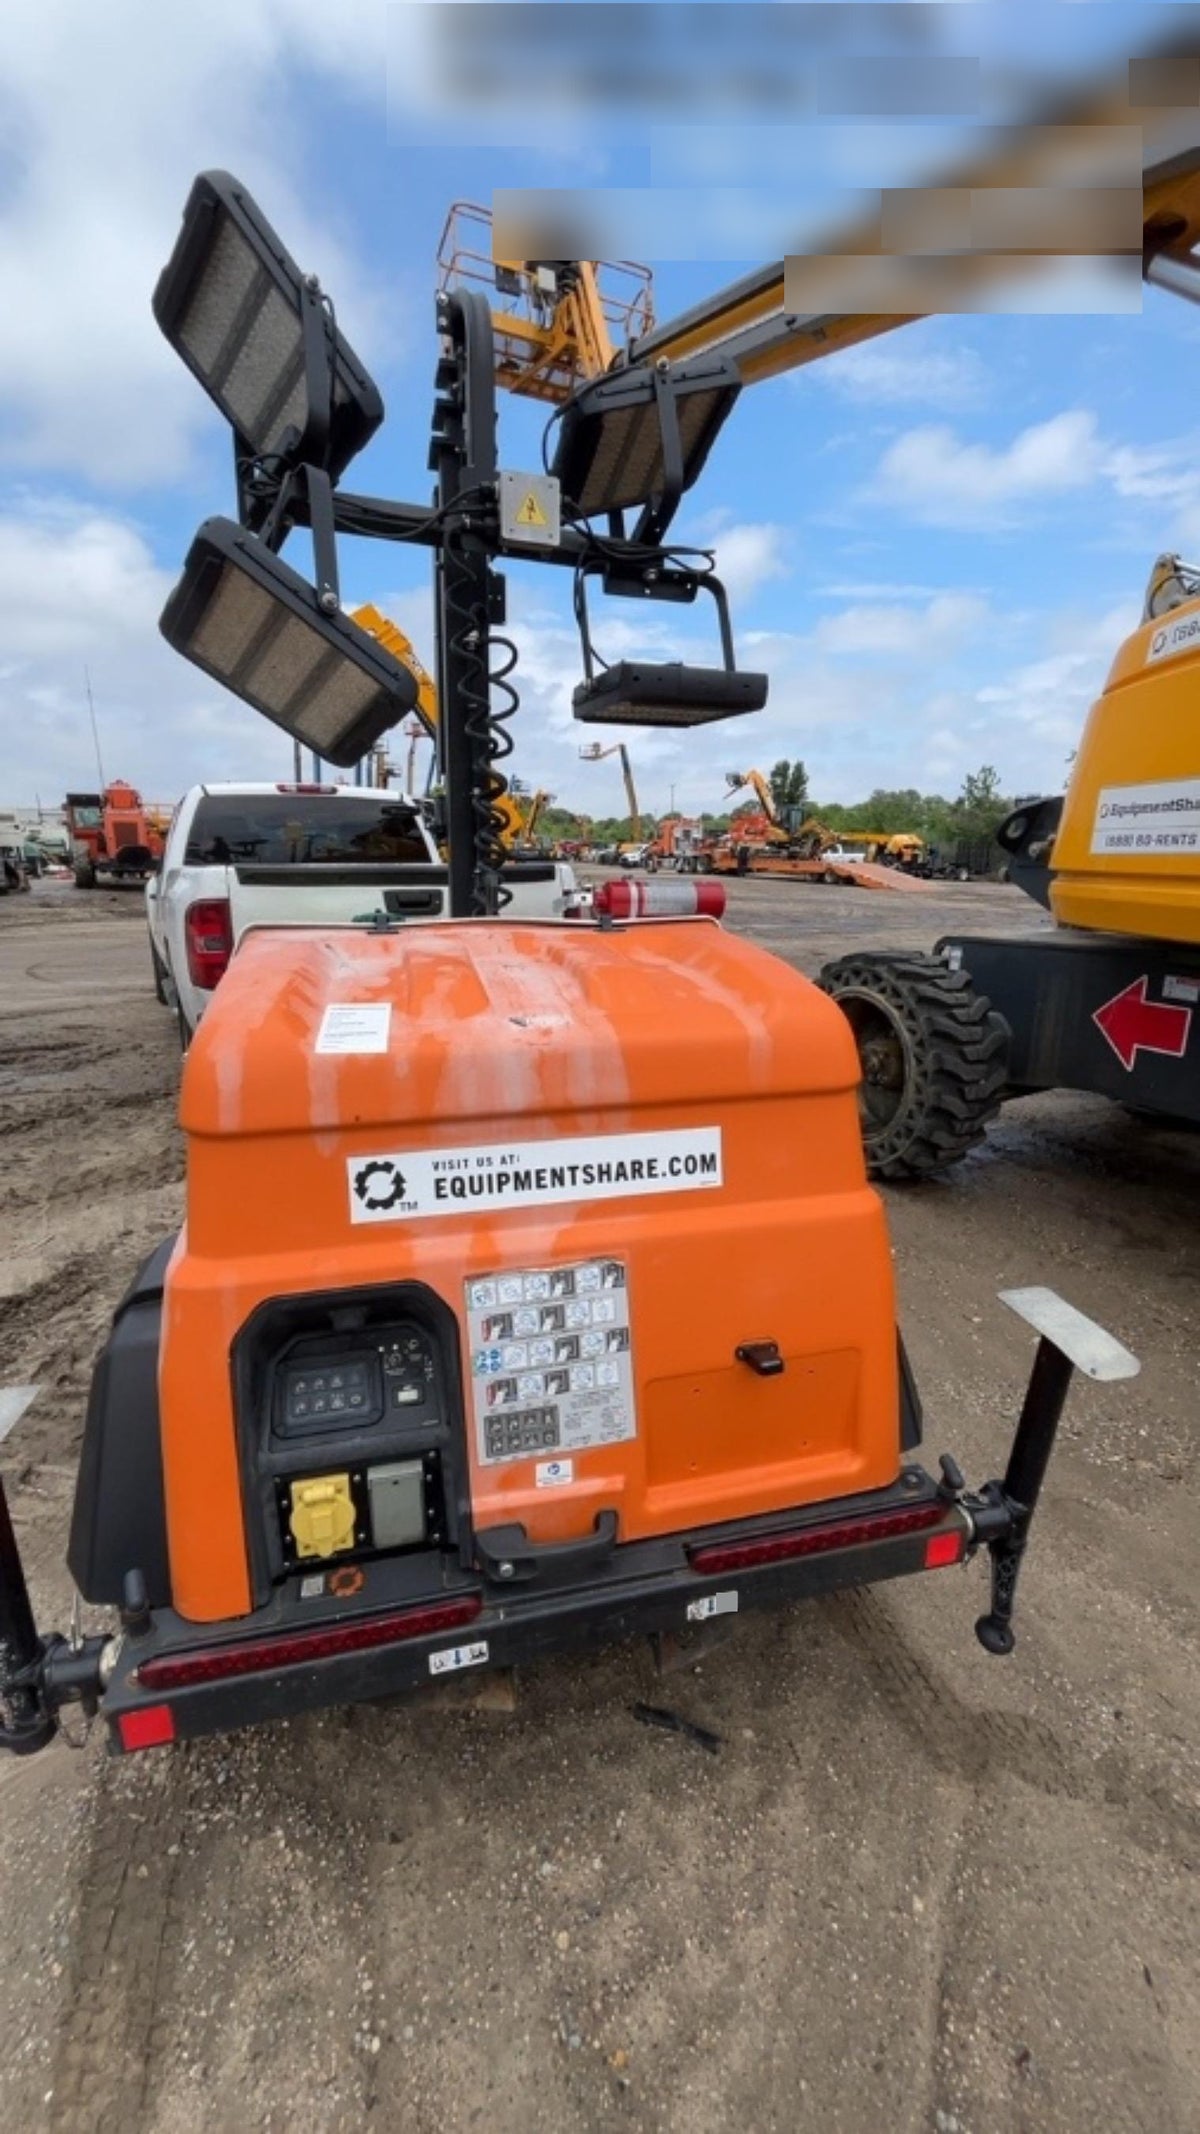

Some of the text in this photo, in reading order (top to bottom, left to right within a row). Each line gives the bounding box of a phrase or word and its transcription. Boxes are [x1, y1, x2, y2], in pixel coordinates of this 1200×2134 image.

[432, 1154, 521, 1172] VISIT US AT:
[433, 1152, 718, 1200] EQUIPMENTSHARE.COM
[399, 1201, 419, 1212] TM
